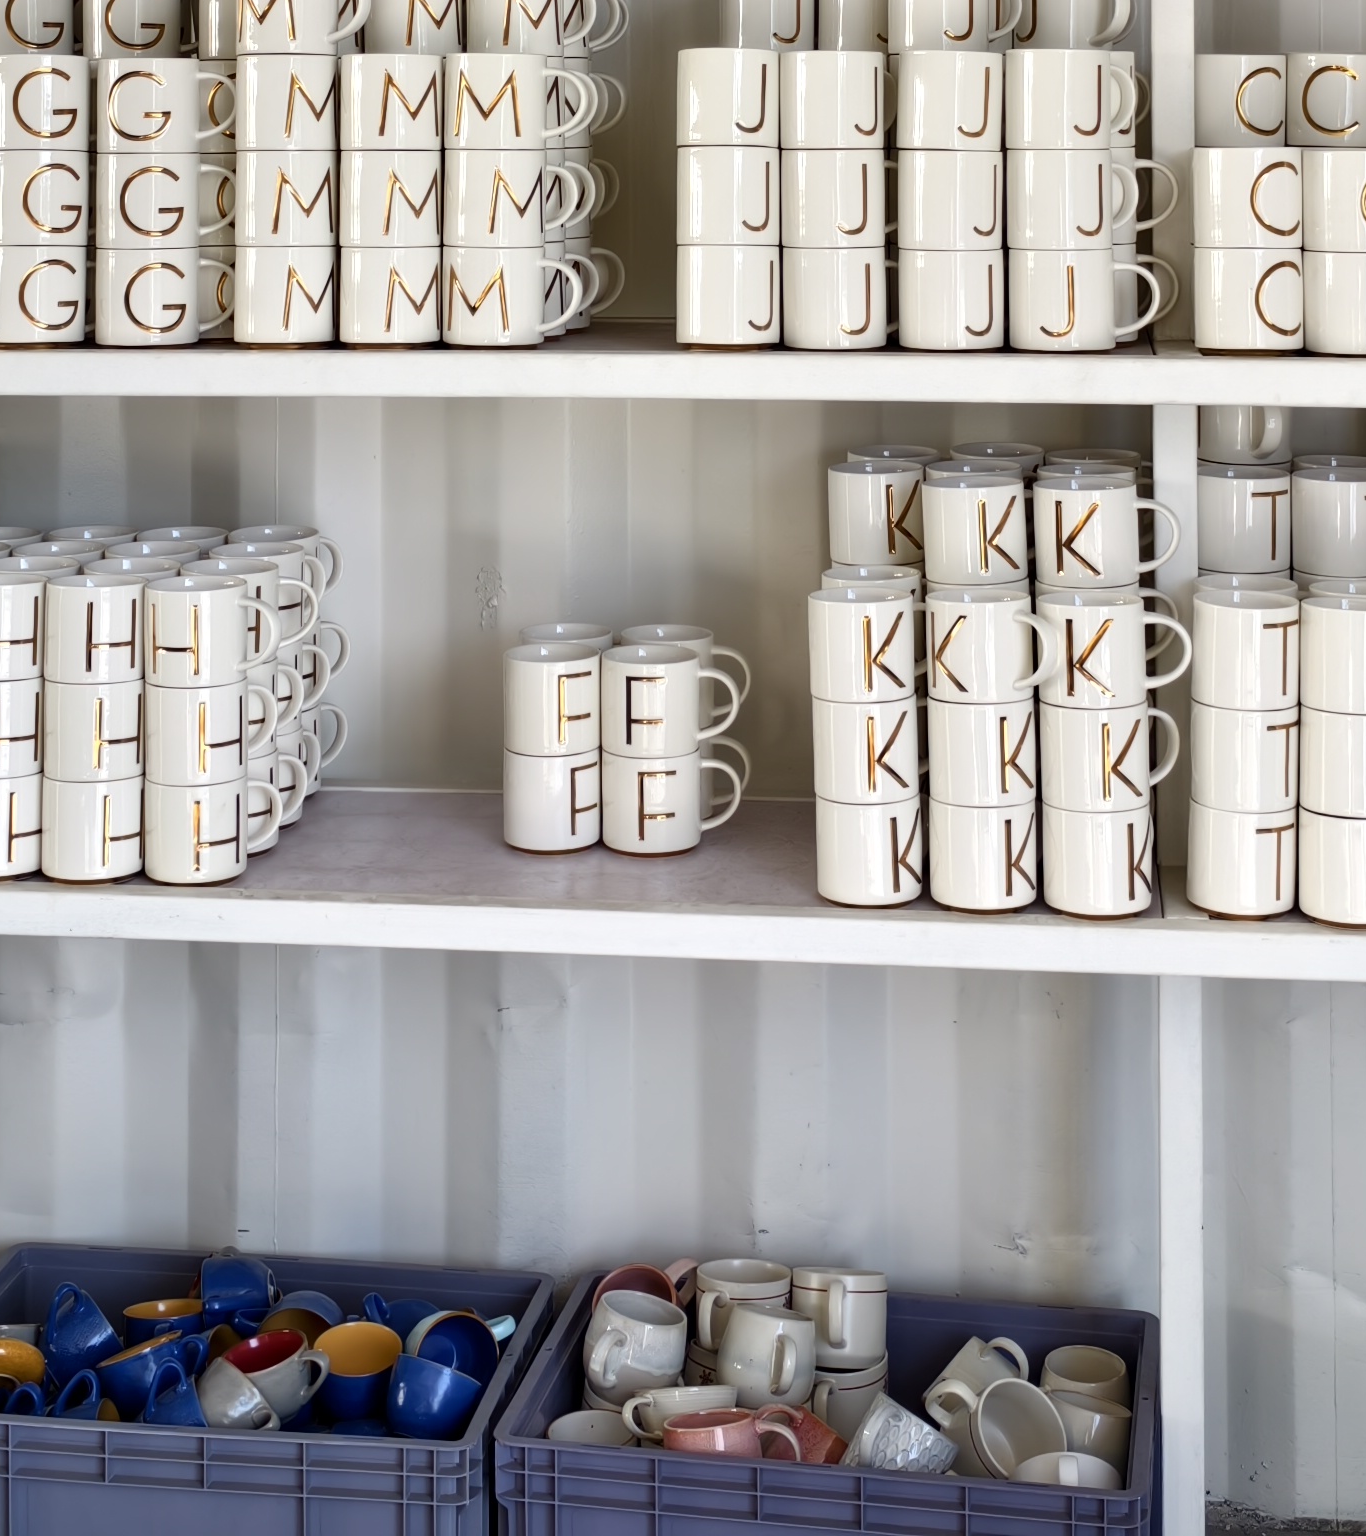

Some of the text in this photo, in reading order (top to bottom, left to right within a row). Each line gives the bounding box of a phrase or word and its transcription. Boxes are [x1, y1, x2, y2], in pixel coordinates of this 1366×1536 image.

[108, 71, 171, 142] G
[379, 69, 438, 136] M
[453, 70, 522, 137] M
[736, 64, 766, 133] J
[958, 67, 990, 138] J
[1073, 65, 1101, 136] J
[1236, 66, 1283, 136] C
[1302, 65, 1361, 136] C
[120, 166, 184, 236] G
[272, 166, 333, 235] M
[1076, 164, 1102, 236] J
[1251, 162, 1299, 236] C
[124, 262, 186, 334] G
[449, 264, 509, 333] M
[840, 263, 870, 336] J
[1040, 265, 1073, 338] J
[978, 495, 1019, 574] K
[1055, 501, 1101, 577] K
[1251, 490, 1288, 561] T
[86, 598, 137, 671] H
[152, 603, 199, 675] H
[863, 612, 905, 692] K
[931, 614, 967, 692] K
[1066, 618, 1115, 697] K
[199, 695, 243, 773] H
[558, 670, 591, 745] F
[626, 676, 665, 745] F
[1102, 718, 1143, 802] K
[571, 761, 597, 836] F
[638, 770, 676, 841] F
